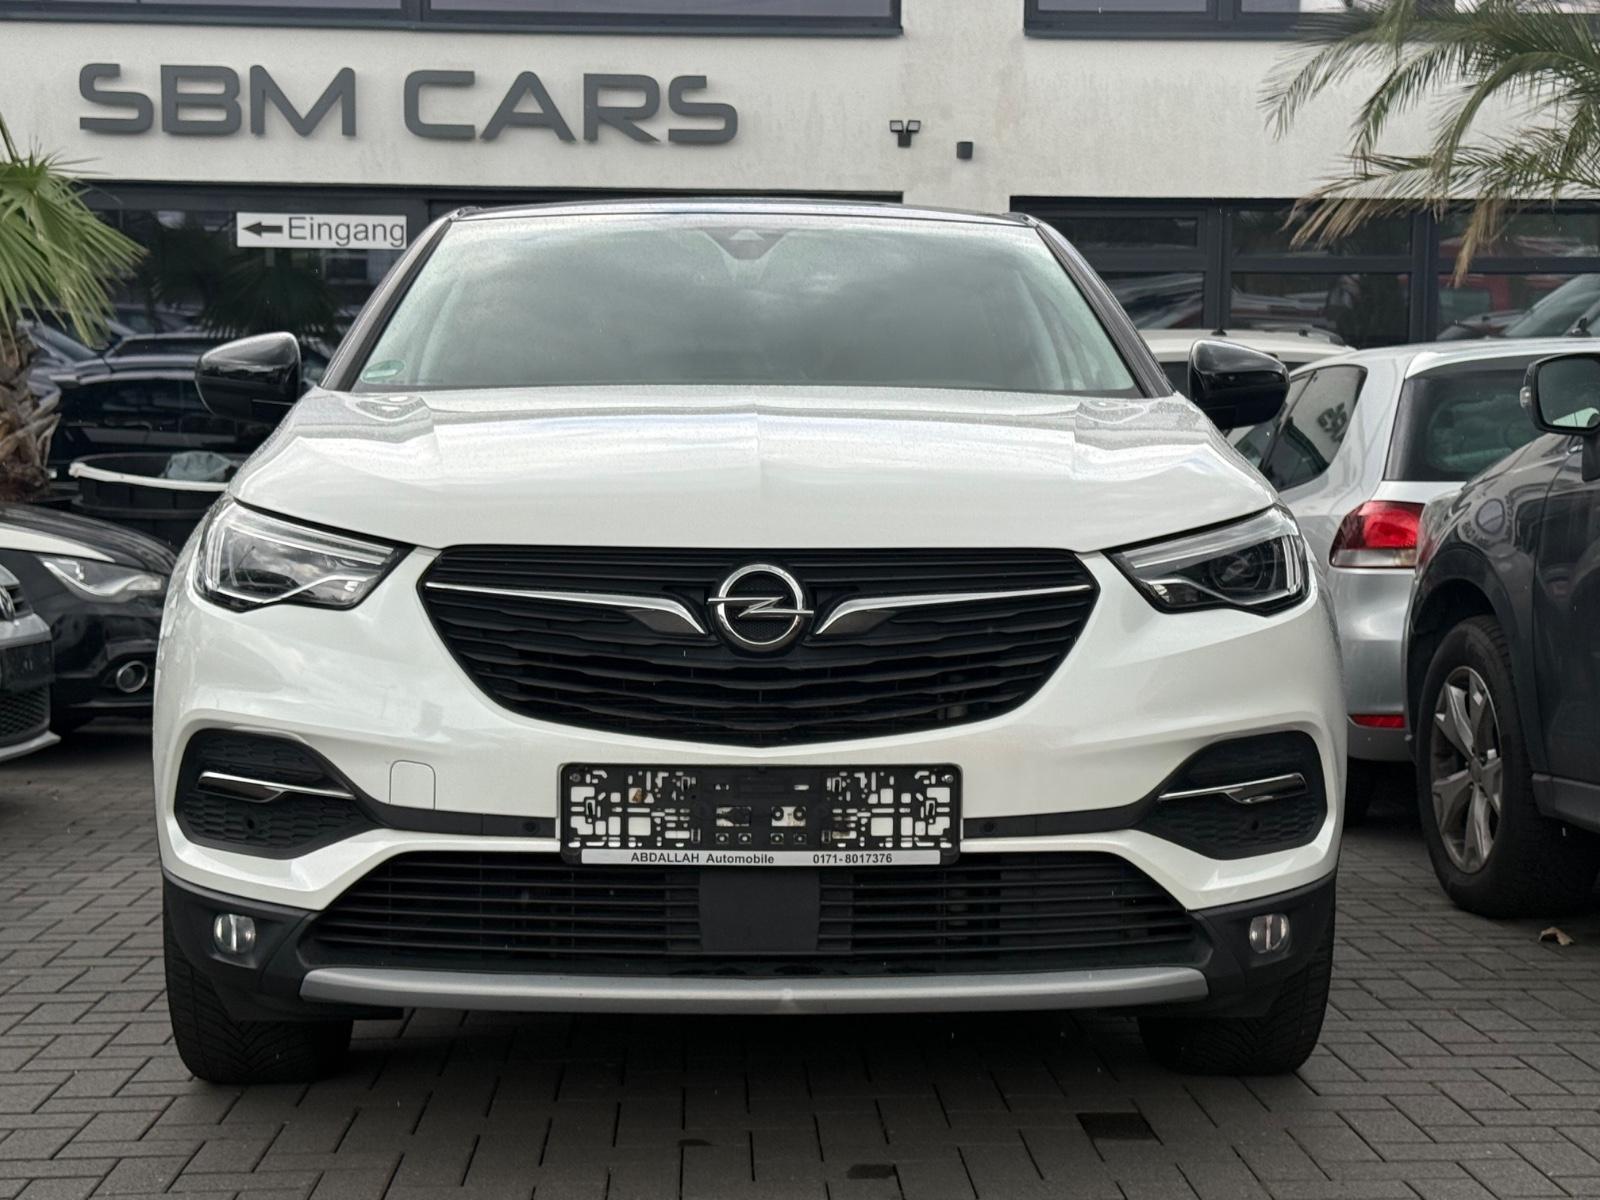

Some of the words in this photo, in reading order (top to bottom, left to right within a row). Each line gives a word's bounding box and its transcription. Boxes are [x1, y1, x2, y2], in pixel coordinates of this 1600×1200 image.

[79, 63, 356, 137] SBM
[404, 70, 738, 144] CARS
[288, 216, 405, 248] Eingang
[631, 852, 700, 863] ABDALLAH
[705, 853, 775, 864] Automobile
